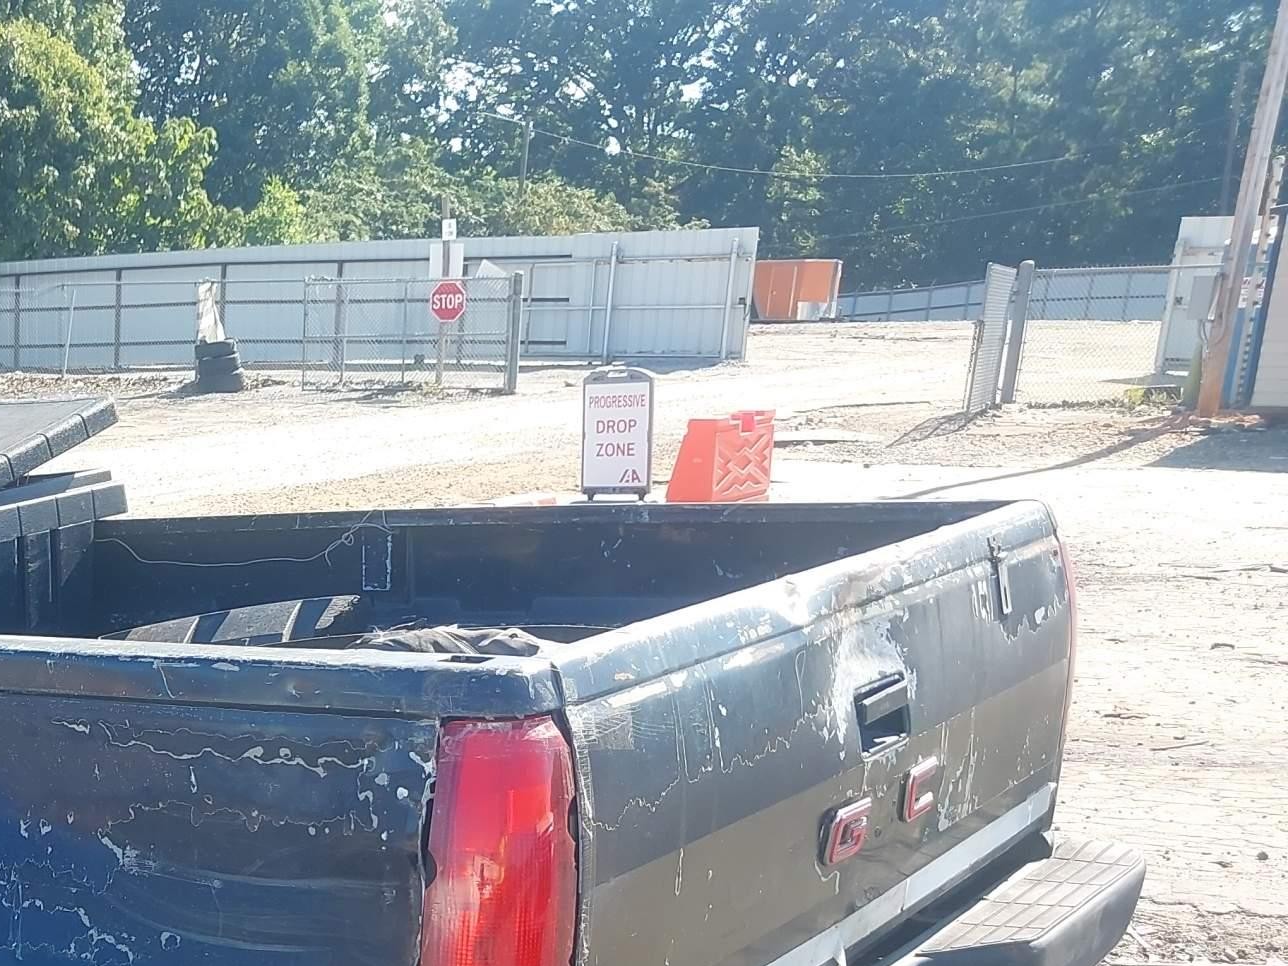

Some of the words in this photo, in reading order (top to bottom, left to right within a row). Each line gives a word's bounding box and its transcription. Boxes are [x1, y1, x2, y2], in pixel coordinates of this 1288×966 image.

[432, 293, 463, 310] STOP
[589, 394, 646, 408] PROGRESSIVE
[596, 419, 637, 434] DROP
[596, 443, 635, 457] ZONE
[824, 797, 872, 865] G
